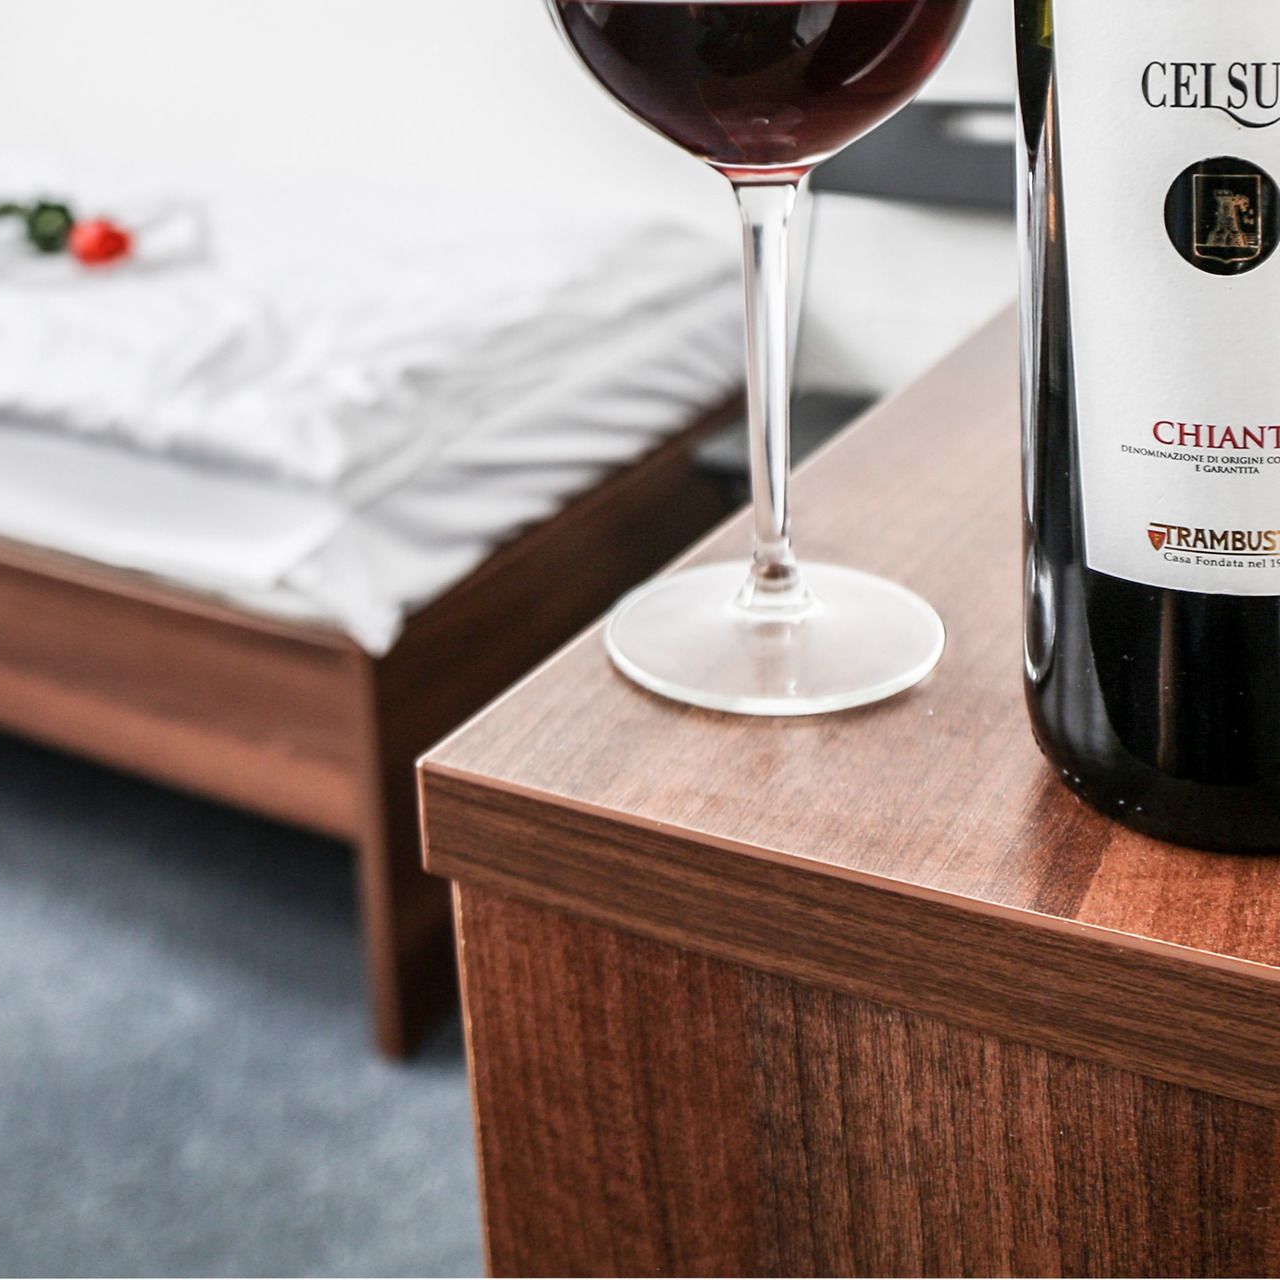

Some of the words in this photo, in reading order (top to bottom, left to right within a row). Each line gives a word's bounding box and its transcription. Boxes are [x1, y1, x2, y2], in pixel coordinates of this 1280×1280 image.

[1121, 444, 1205, 463] DENOMINAZIONE
[1207, 455, 1219, 464] DI
[1221, 455, 1264, 465] ORIGINE
[1195, 465, 1201, 473] E
[1203, 465, 1260, 474] GARANTITA
[1163, 552, 1191, 564] Casa
[1196, 555, 1244, 568] Fondata
[1248, 558, 1266, 568] nel
